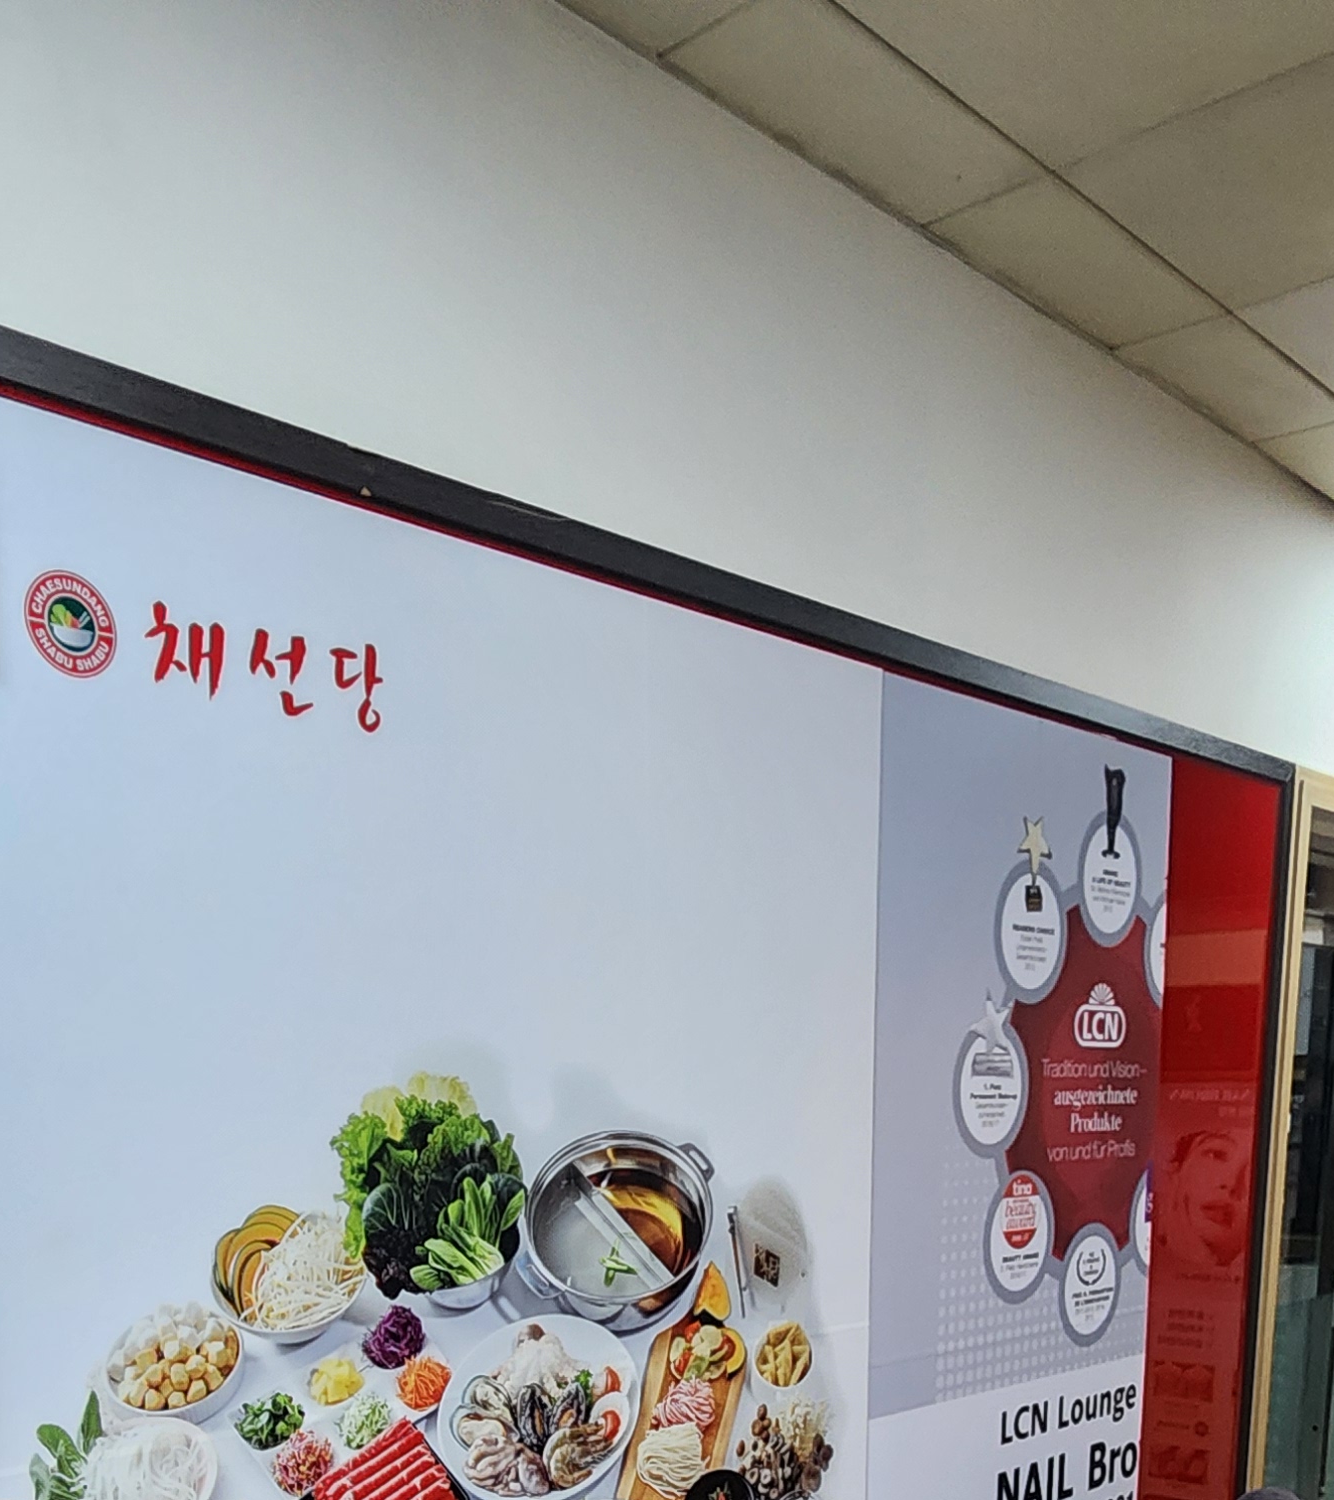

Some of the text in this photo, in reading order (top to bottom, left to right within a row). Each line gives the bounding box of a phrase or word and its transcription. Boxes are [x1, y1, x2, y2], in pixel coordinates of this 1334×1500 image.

[30, 577, 110, 628] CHAESUNDANG
[34, 627, 110, 671] SHABU SHABU
[143, 600, 384, 733] 채선당
[1081, 1011, 1118, 1041] LCN
[1041, 1058, 1087, 1078] Tradition
[1087, 1061, 1110, 1079] und
[1054, 1083, 1138, 1111] ausgezeichnete
[1069, 1110, 1123, 1133] Produkte
[1047, 1147, 1068, 1162] von
[1069, 1142, 1091, 1160] und
[1107, 1139, 1136, 1158] Profis
[1000, 1383, 1137, 1445] LCN Lounge
[1088, 1439, 1137, 1491] Bro
